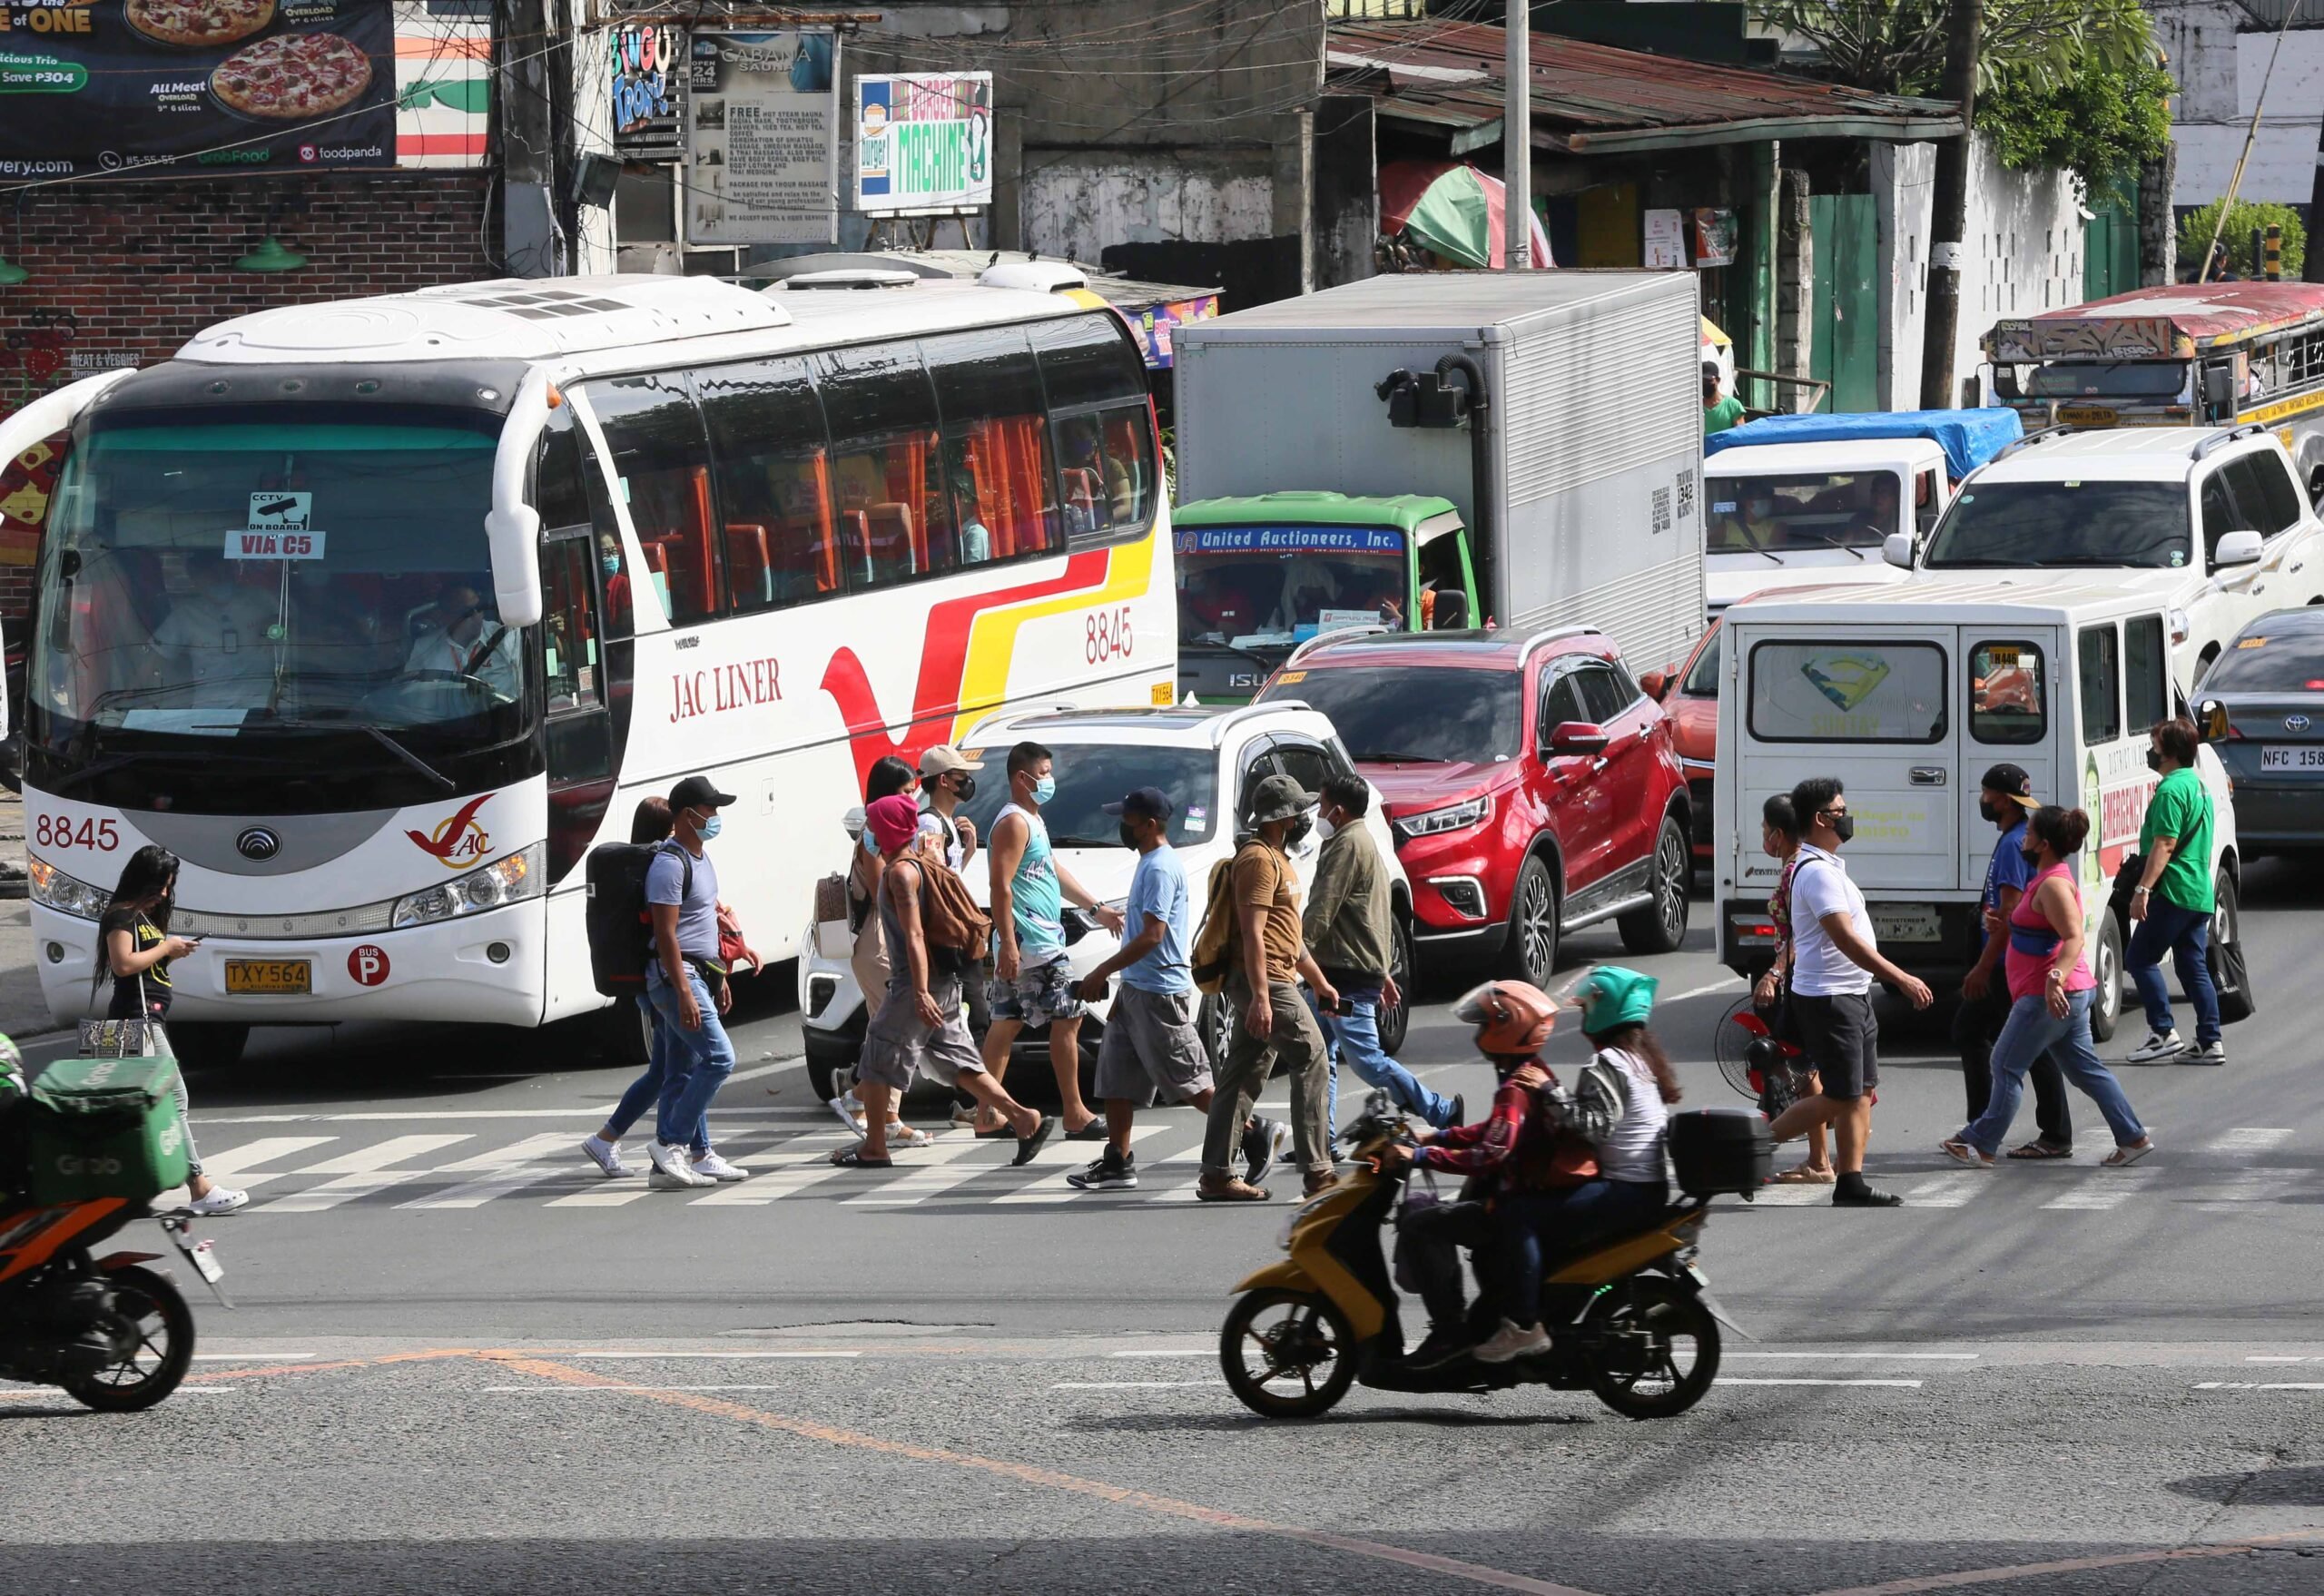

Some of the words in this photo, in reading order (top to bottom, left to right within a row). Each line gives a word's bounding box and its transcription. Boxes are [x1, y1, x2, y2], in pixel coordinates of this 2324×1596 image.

[285, 6, 334, 16] OVERLOAD
[13, 14, 27, 25] of
[29, 7, 92, 33] ONE
[35, 55, 58, 65] Trio
[721, 48, 812, 63] CABANA
[693, 67, 716, 77] 24
[739, 64, 795, 72] SAUNA
[3, 72, 33, 83] Save
[150, 83, 170, 94] All
[172, 81, 206, 93] Meat
[158, 94, 198, 102] OVERLOAD
[911, 79, 955, 121] BURGER
[730, 107, 761, 117] FREE
[319, 145, 382, 160] foodpanda
[898, 122, 966, 193] MACHINE
[70, 353, 94, 367] MEAT
[96, 354, 103, 367] &
[1677, 483, 1693, 505] 1342
[241, 535, 277, 555] VIA
[282, 536, 312, 555] C5
[1202, 531, 1252, 547] United
[1260, 530, 1357, 548] Auctioneers,
[1367, 531, 1394, 547] Inc.
[1086, 606, 1133, 665] 8845
[1229, 673, 1268, 687] ISU
[670, 670, 707, 724] JAC
[713, 657, 783, 712] LINER
[2262, 750, 2290, 766] NFC
[2299, 750, 2324, 766] 158
[2102, 783, 2144, 842] EMERGENCY
[36, 813, 120, 852] 8845
[359, 948, 379, 957] BUS
[359, 957, 379, 984] P
